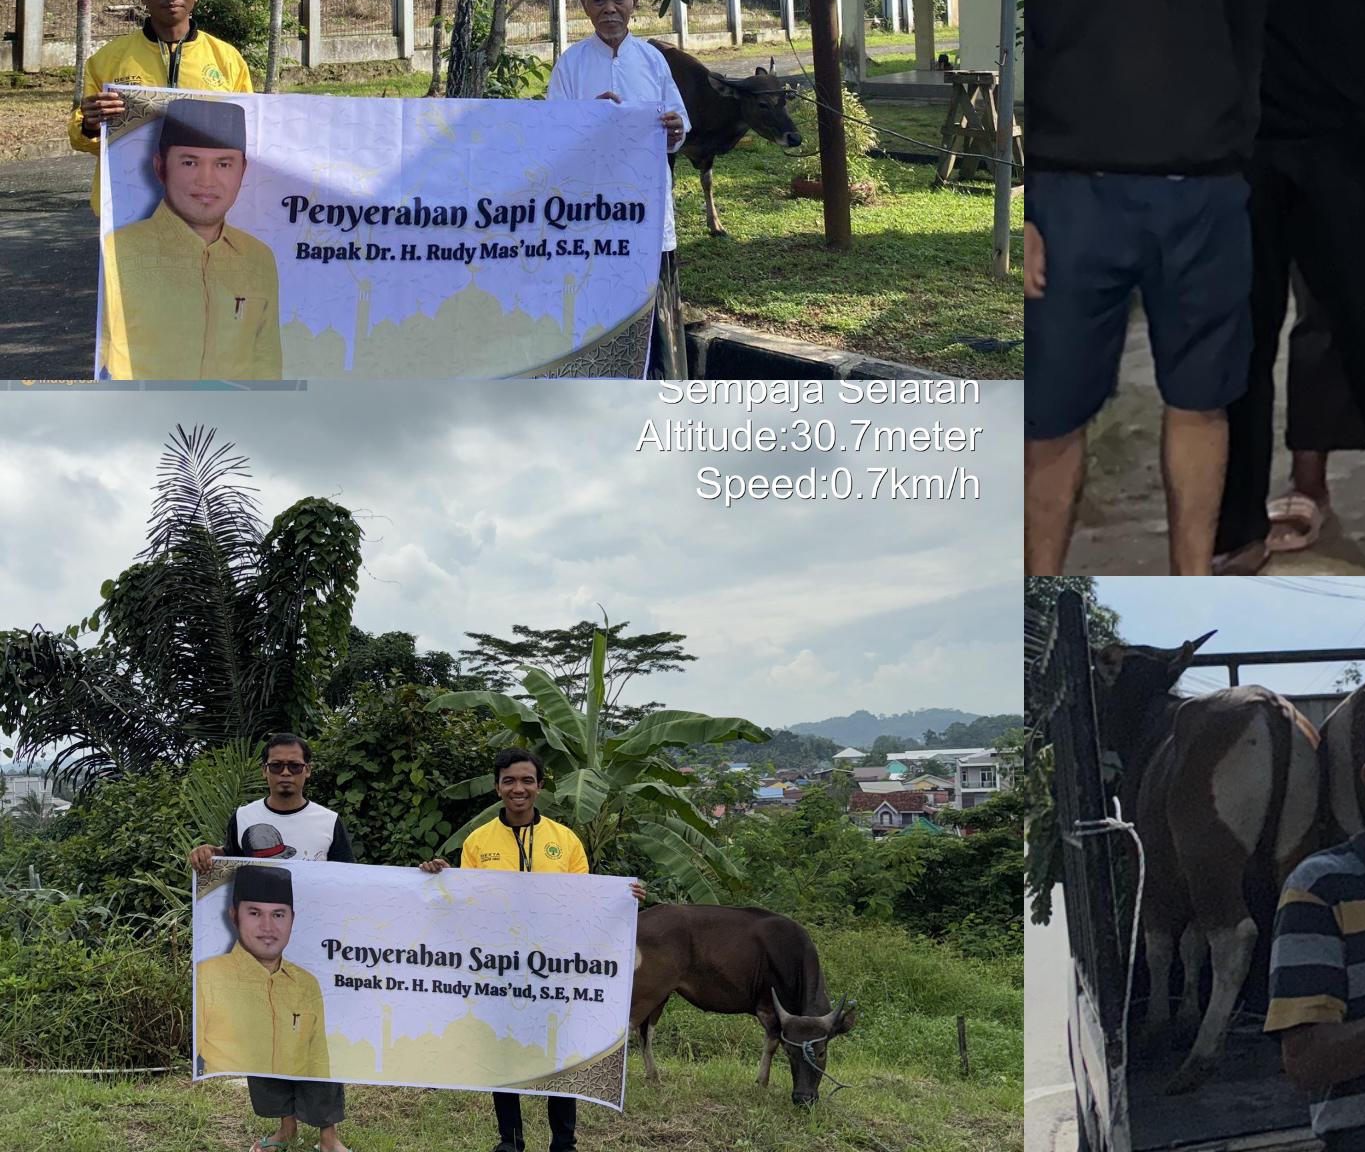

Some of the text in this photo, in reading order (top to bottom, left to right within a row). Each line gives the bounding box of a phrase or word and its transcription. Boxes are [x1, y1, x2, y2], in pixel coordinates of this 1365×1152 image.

[282, 194, 645, 232] Penyerahan Sapi Qurban
[296, 242, 361, 263] Bapak
[365, 244, 395, 260] Dr.
[401, 245, 421, 260] H.
[427, 243, 476, 265] Rudy
[556, 239, 590, 259] S.E,
[594, 239, 629, 255] M.E
[322, 939, 617, 979] Penyerahan Sapi Qurban
[335, 975, 382, 990] Bapak
[386, 977, 408, 990] Dr.
[413, 979, 428, 992] H.
[432, 980, 472, 998] Rudy
[540, 987, 569, 1003] S.E,
[573, 988, 604, 1002] M.E
